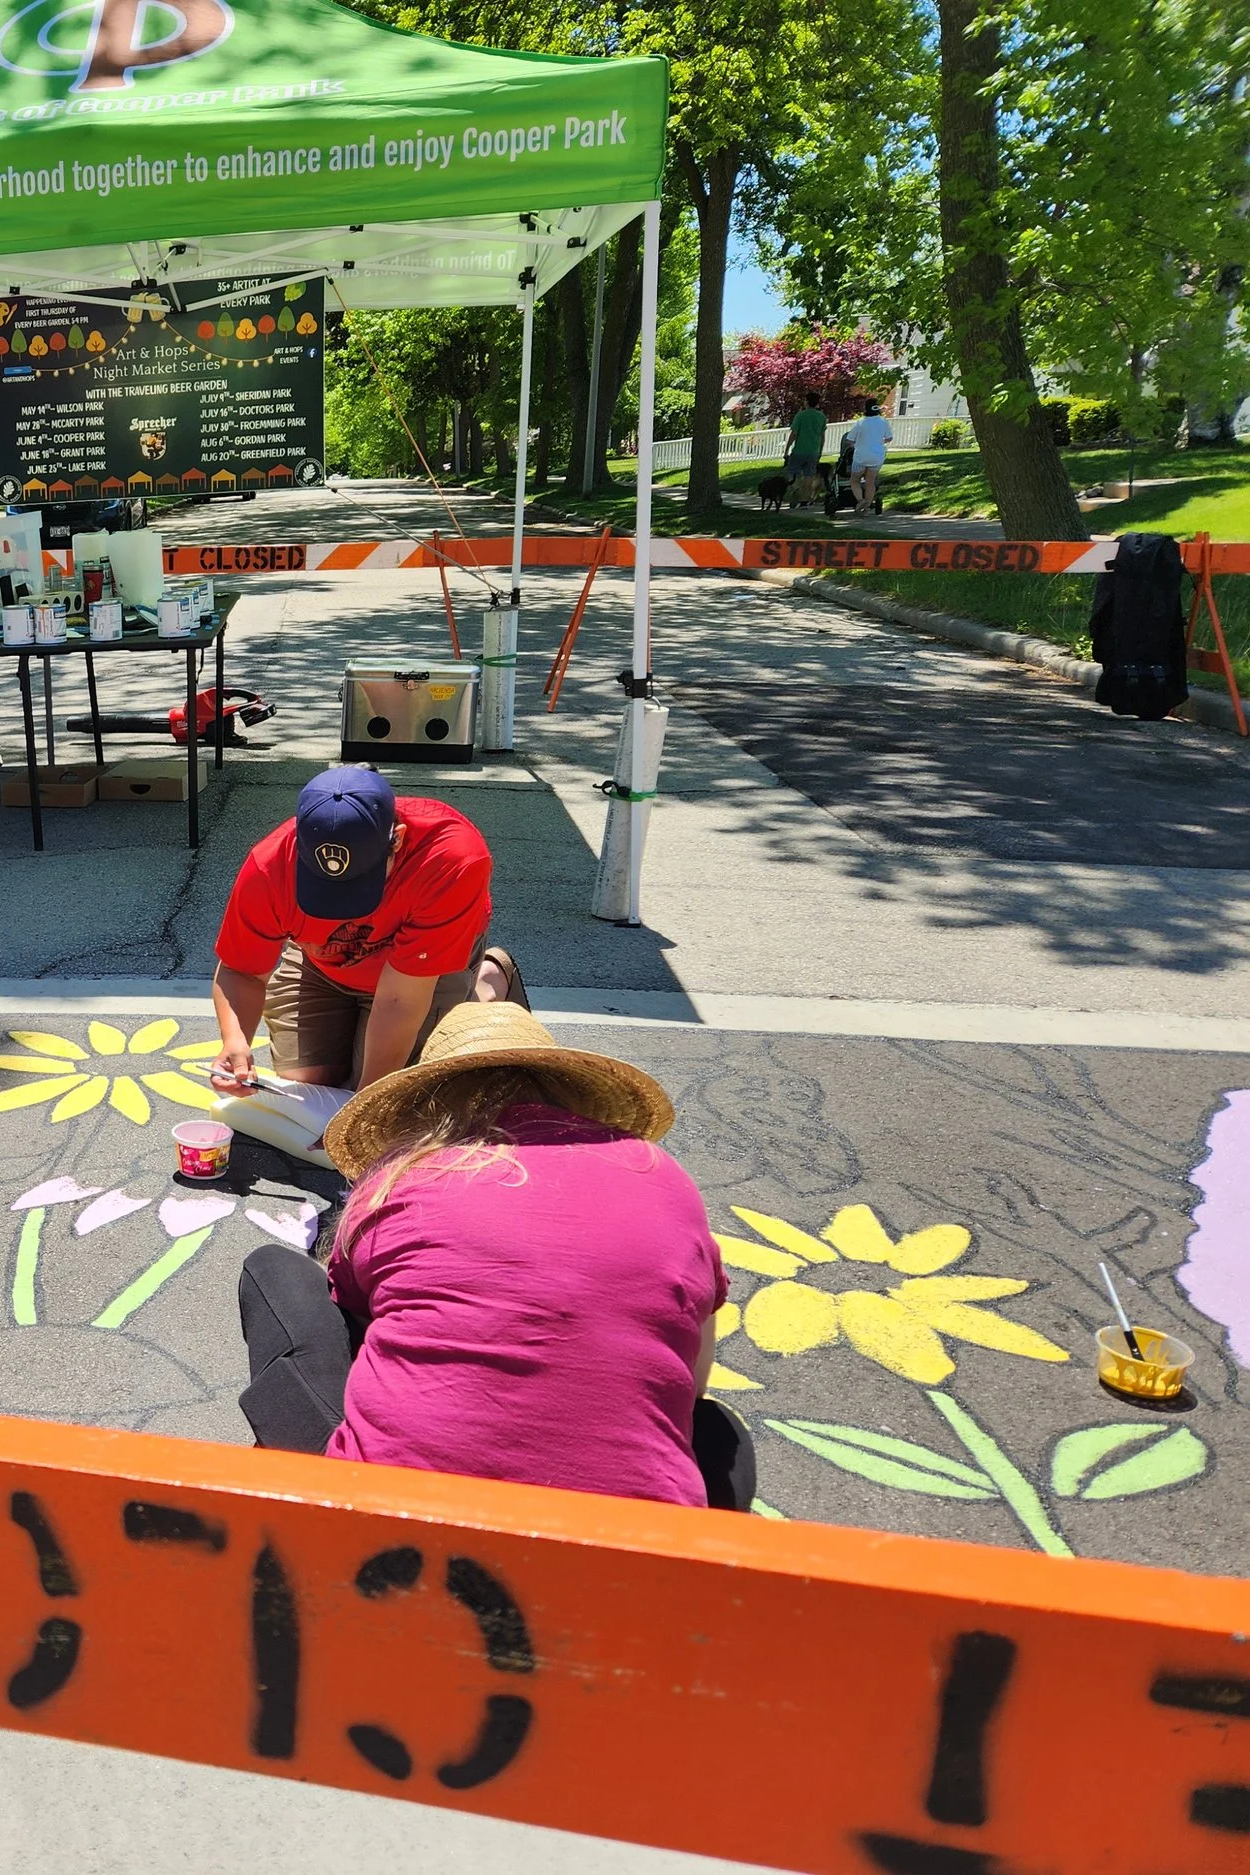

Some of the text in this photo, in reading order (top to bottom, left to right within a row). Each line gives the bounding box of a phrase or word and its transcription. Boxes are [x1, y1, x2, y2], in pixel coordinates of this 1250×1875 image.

[12, 100, 64, 122] of
[66, 88, 222, 117] Cooper
[72, 154, 179, 197] together
[184, 151, 209, 182] to
[217, 145, 321, 181] enhance
[329, 135, 376, 171] and
[384, 129, 455, 172] enjoy
[462, 124, 556, 162] Cooper
[564, 110, 627, 150] Park
[217, 281, 231, 292] 35+
[232, 279, 261, 291] ARTIST
[220, 295, 271, 308] EVERY PARK
[25, 309, 40, 317] FIRST
[14, 320, 33, 329] EVERY
[33, 319, 47, 328] BEER
[116, 346, 189, 361] Art & Hops
[93, 359, 222, 382] Night Market Series
[85, 379, 228, 399] WITH THE TRAVELING BEER GARDEN
[199, 393, 219, 404] JULY
[235, 389, 272, 401] SHERIDAN
[272, 388, 292, 399] PARK
[21, 406, 36, 416] MAY
[56, 402, 84, 414] WILSON
[85, 401, 104, 411] PARK
[200, 408, 219, 419] JULY
[239, 404, 275, 416] DOCTORS
[275, 403, 295, 413] PARK
[15, 421, 31, 431] MAY
[51, 417, 85, 429] MCCARTY
[85, 416, 105, 426] PARK
[129, 416, 178, 431] Sprecher
[200, 423, 219, 433] JULY
[240, 418, 286, 431] FROEMMING
[287, 417, 307, 427] PARK
[16, 435, 37, 446] JUNE
[53, 432, 85, 443] COOPER
[86, 431, 105, 441] PARK
[200, 438, 218, 448] AUG
[234, 434, 267, 446] GORDAN
[267, 433, 287, 443] PARK
[20, 450, 41, 461] JUNE
[60, 447, 86, 458] GRANT
[86, 446, 106, 456] PARK
[200, 452, 218, 462] AUG
[241, 447, 286, 460] GREENFIELD
[287, 446, 307, 457] PARK
[27, 464, 47, 475] JUNE
[68, 461, 86, 472] LAKE
[87, 461, 107, 471] PARK
[200, 546, 305, 570] CLOSED
[760, 540, 1040, 572] STREET CLOSED
